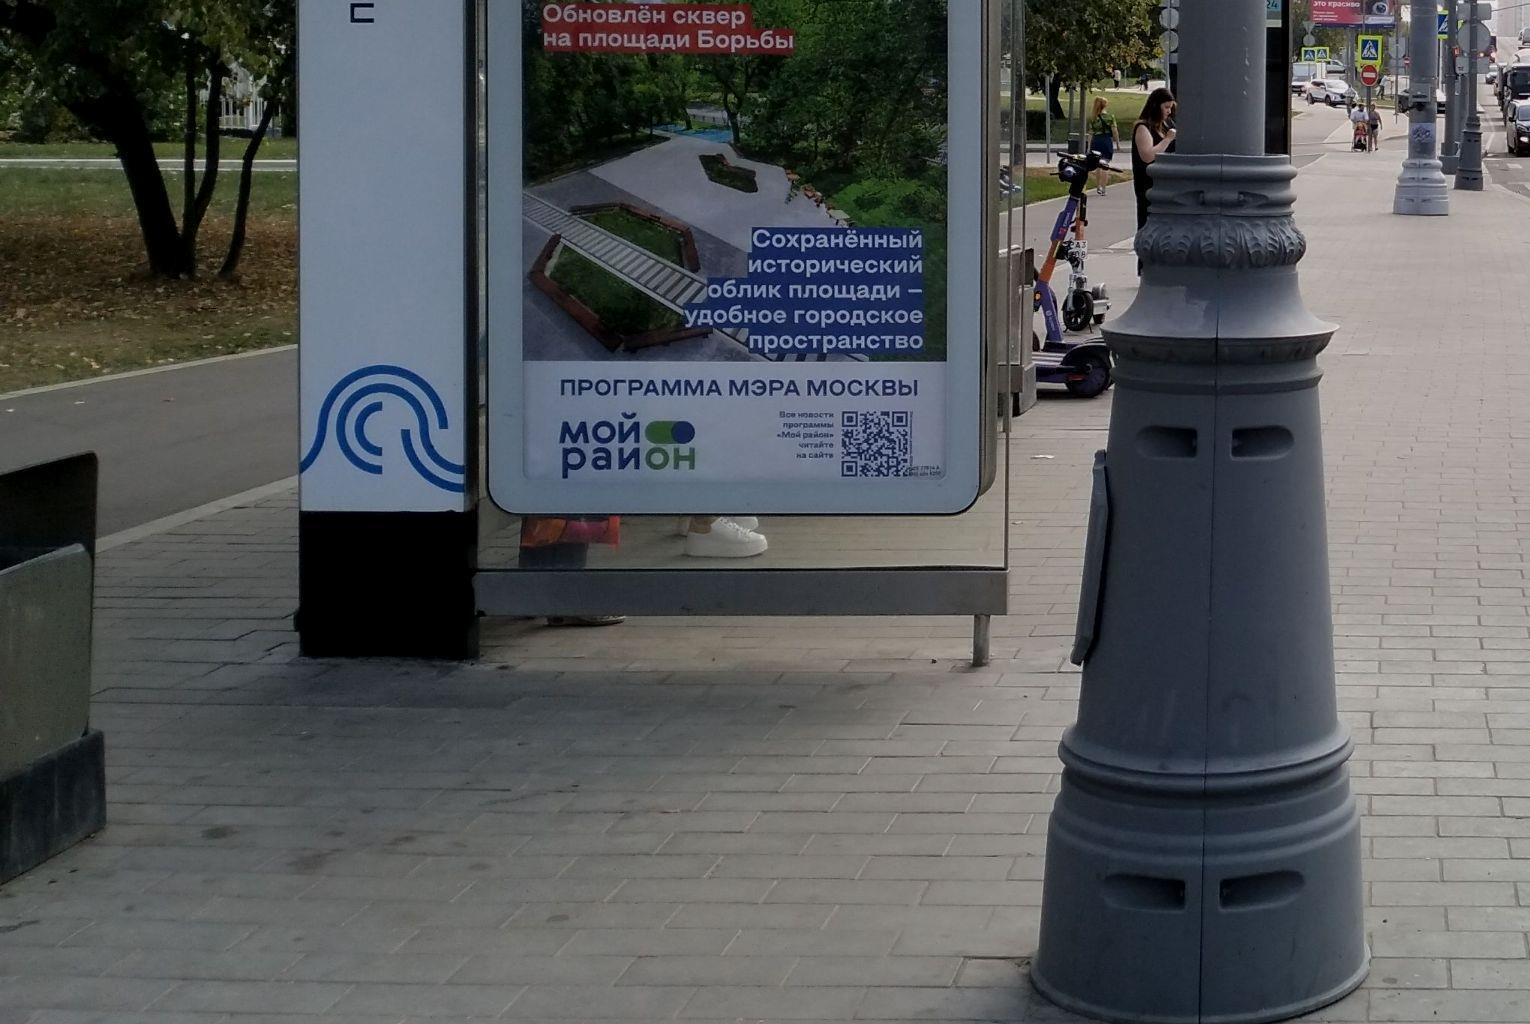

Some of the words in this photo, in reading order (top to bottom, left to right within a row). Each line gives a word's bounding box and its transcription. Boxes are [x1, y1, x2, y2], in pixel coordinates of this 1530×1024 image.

[543, 4, 666, 23] Обновлён
[672, 10, 745, 29] сквер
[543, 32, 572, 46] на
[578, 32, 690, 51] площади
[698, 29, 794, 52] Борьбы
[752, 229, 923, 252] Сохранённый
[748, 255, 923, 277] исторический
[708, 280, 782, 299] облик
[789, 284, 901, 301] площади
[684, 305, 787, 328] удобное
[794, 309, 924, 328] городское
[749, 335, 924, 353] пространство
[560, 379, 722, 397] ПРОГРАММА
[728, 379, 800, 397] МЭРА
[806, 379, 918, 397] МОСКВЫ
[559, 412, 640, 444] мой
